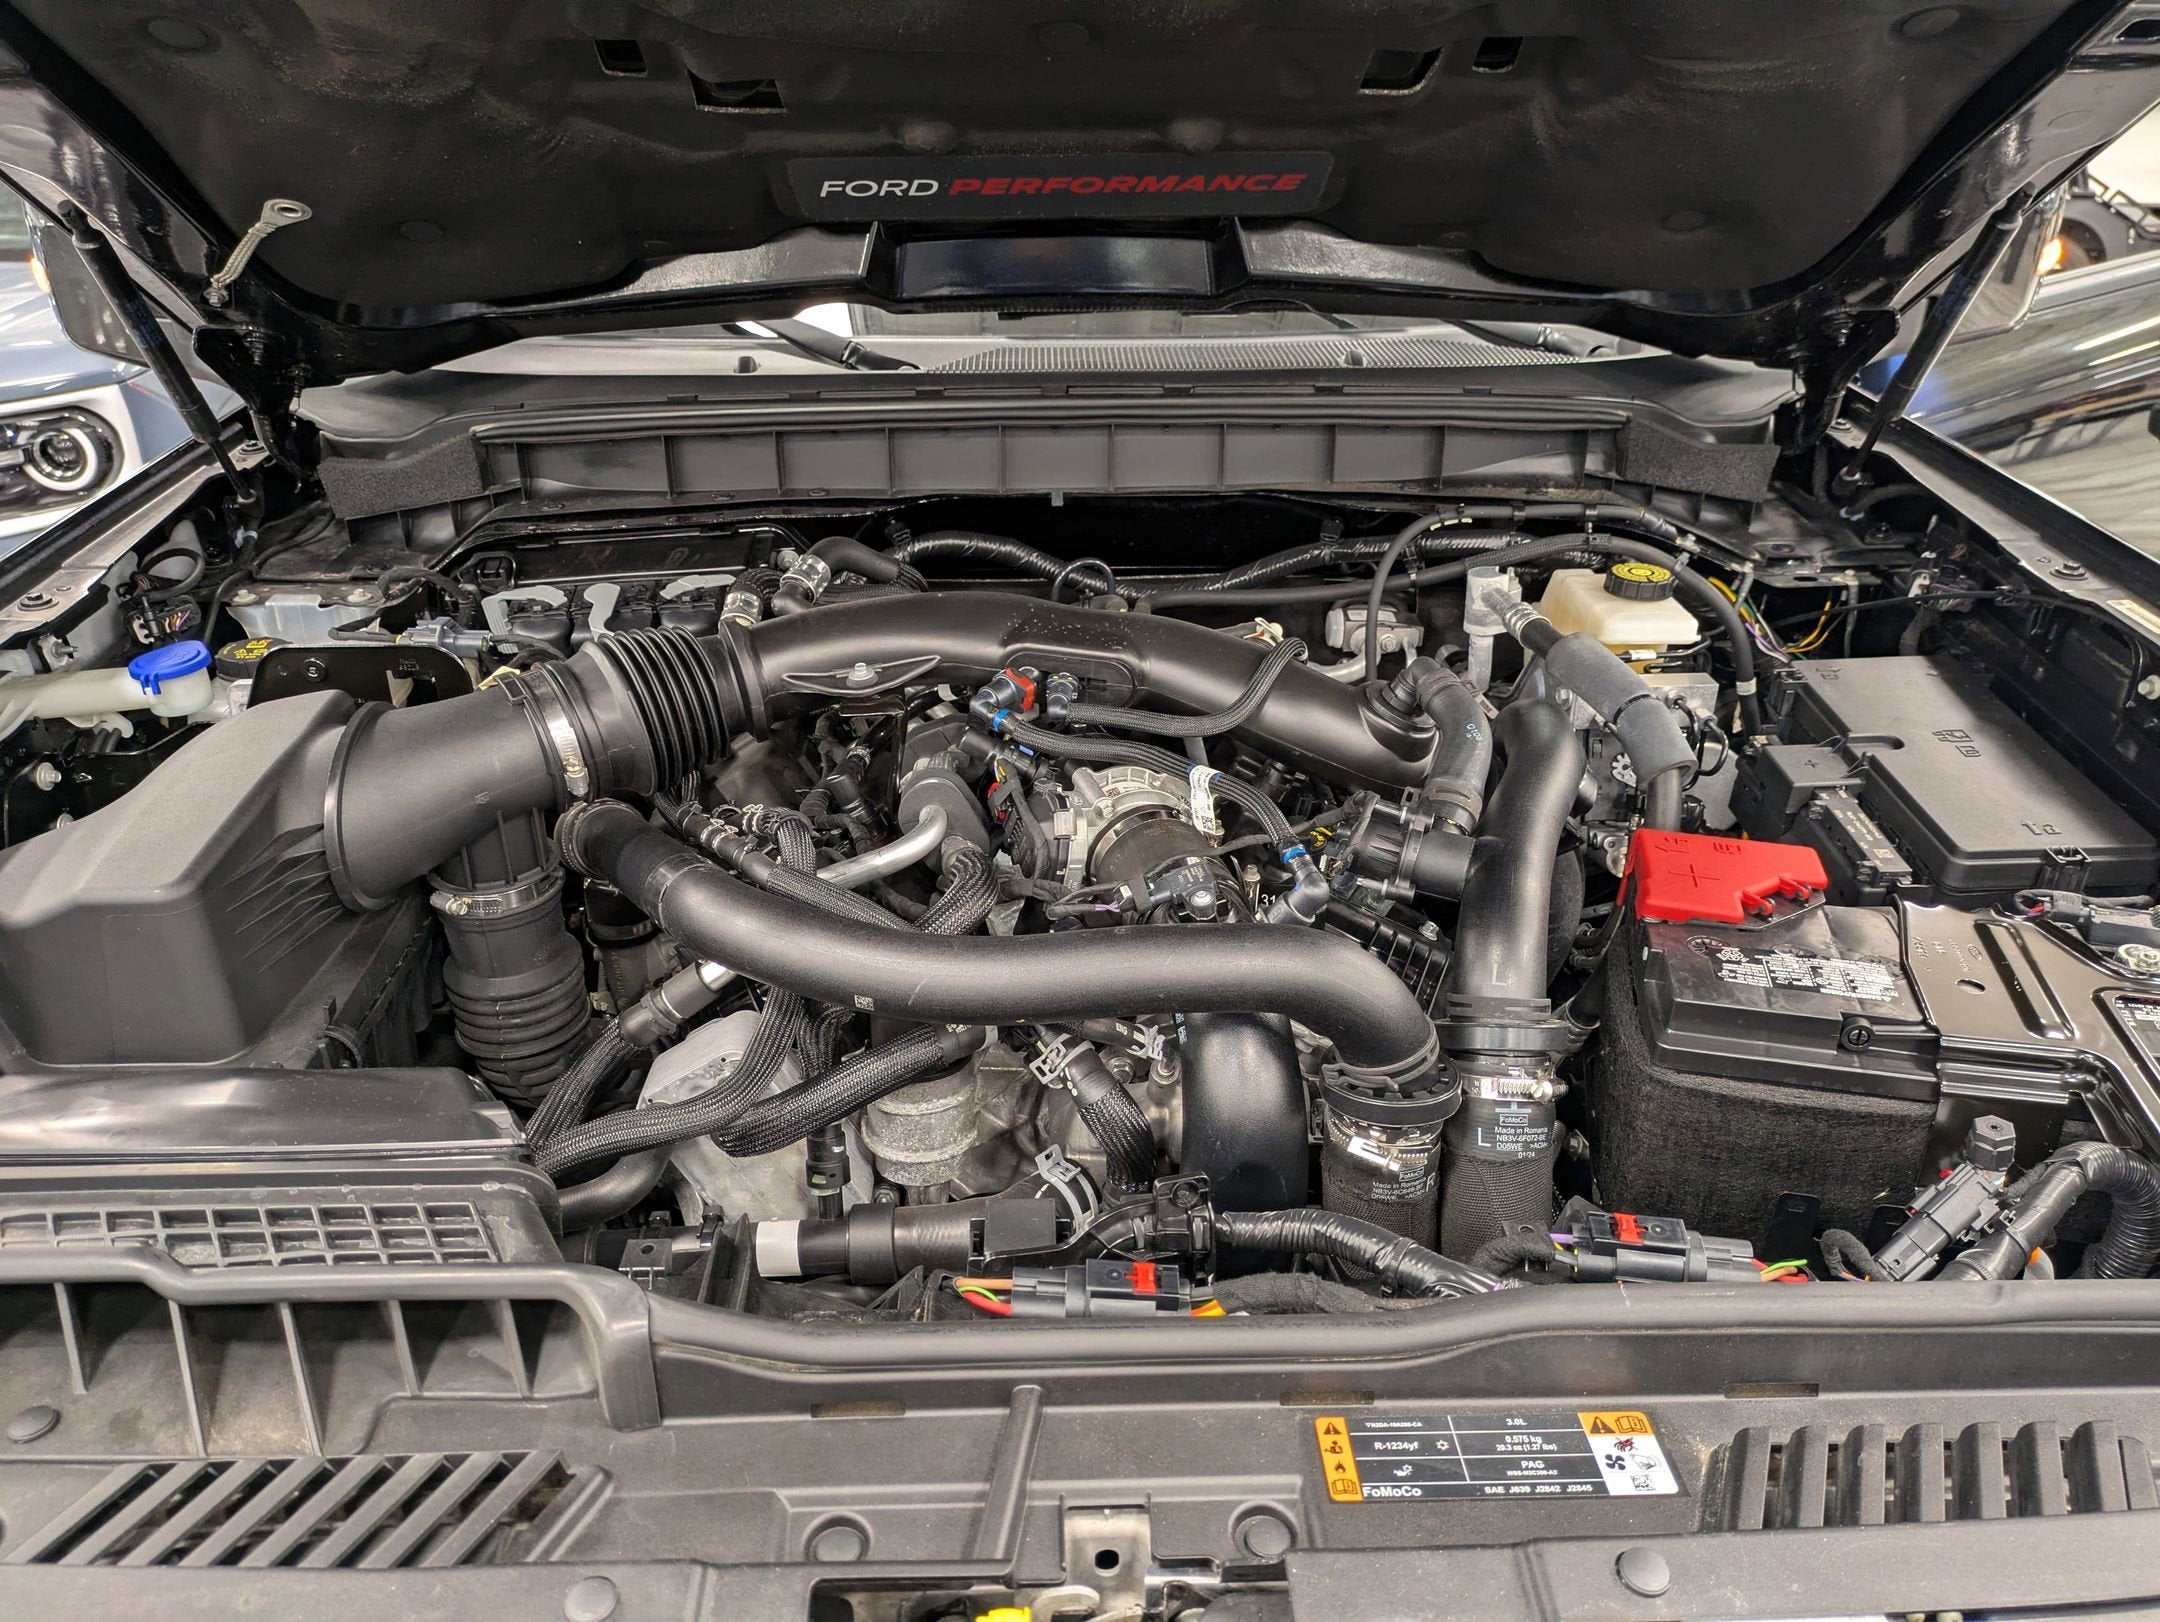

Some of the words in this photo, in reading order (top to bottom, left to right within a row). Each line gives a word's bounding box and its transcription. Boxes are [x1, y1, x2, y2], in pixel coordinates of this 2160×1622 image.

[819, 179, 939, 198] FORD
[949, 173, 1307, 196] PERFORMANCE
[1478, 1127, 1491, 1147] L
[1372, 1181, 1391, 1189] Made
[1425, 1172, 1436, 1192] R
[1506, 1418, 1528, 1426] 3.0L
[1505, 1435, 1529, 1443] 0.575
[1530, 1434, 1542, 1444] kg
[1374, 1441, 1419, 1451] R-1234yf
[1521, 1460, 1544, 1469] PAG
[1363, 1486, 1422, 1498] FoMoCo
[1484, 1486, 1505, 1494] SAE
[1509, 1485, 1530, 1494] J639
[1535, 1485, 1561, 1493] J2842
[1566, 1484, 1593, 1493] J2845
